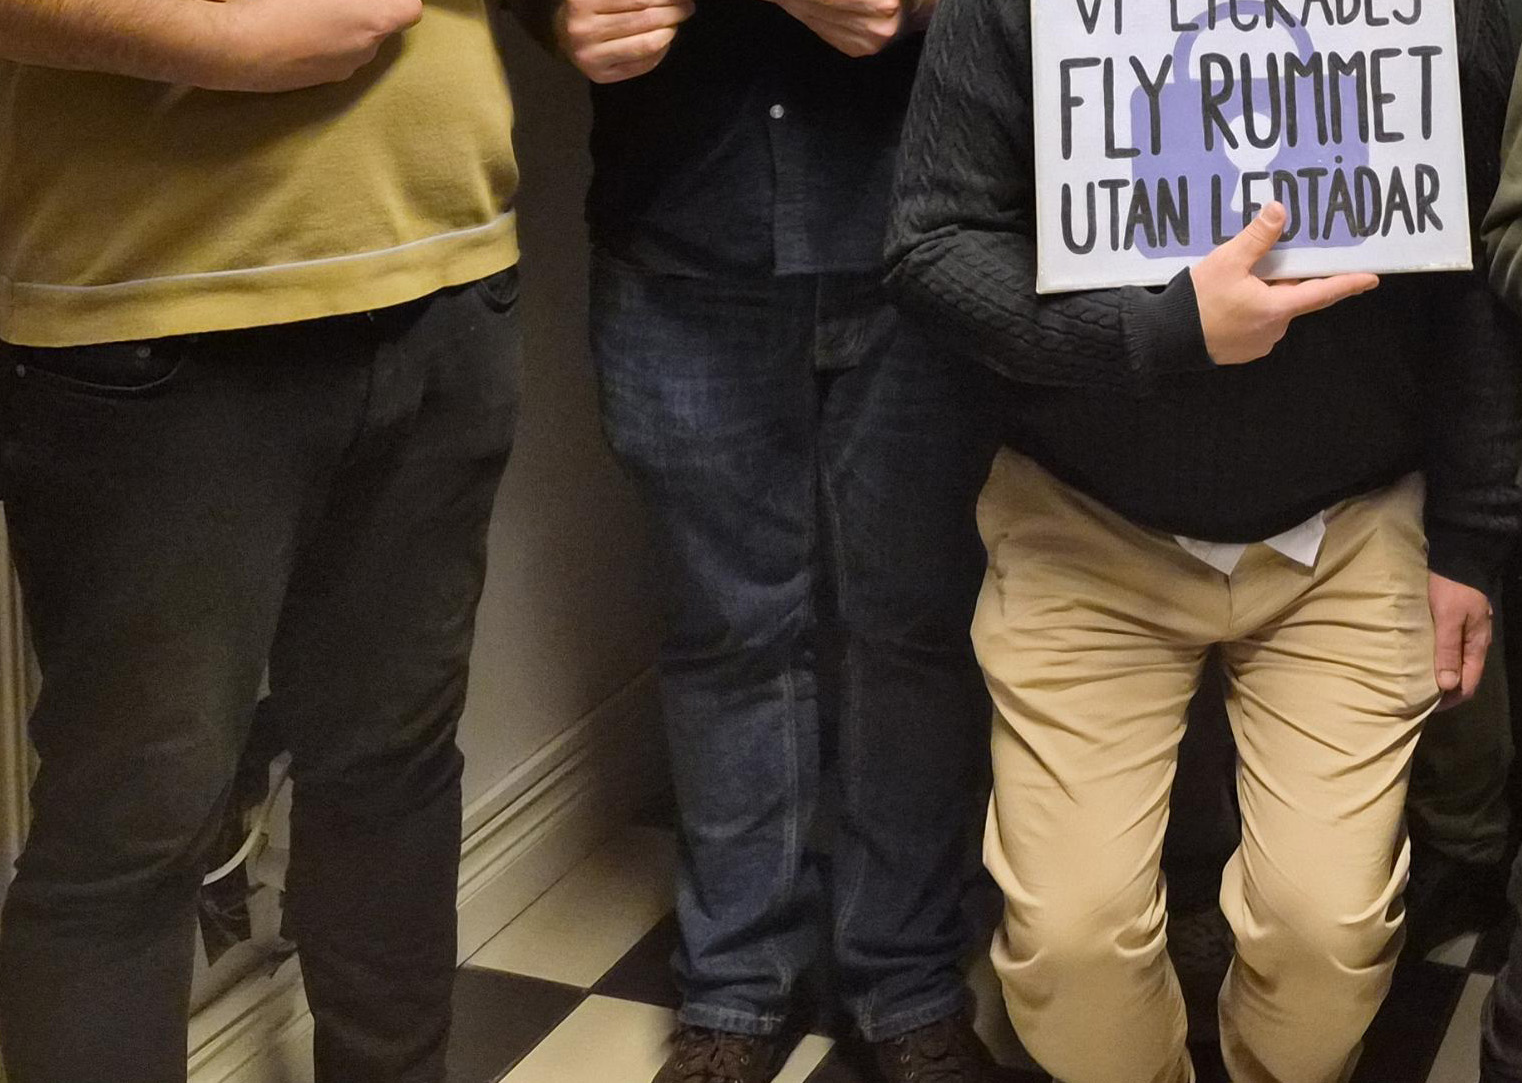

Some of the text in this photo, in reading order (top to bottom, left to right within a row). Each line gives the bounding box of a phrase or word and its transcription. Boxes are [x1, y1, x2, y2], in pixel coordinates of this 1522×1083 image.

[1059, 45, 1443, 160] FLY RUMMET
[1061, 155, 1444, 255] UTAN LEDTÅDAR
